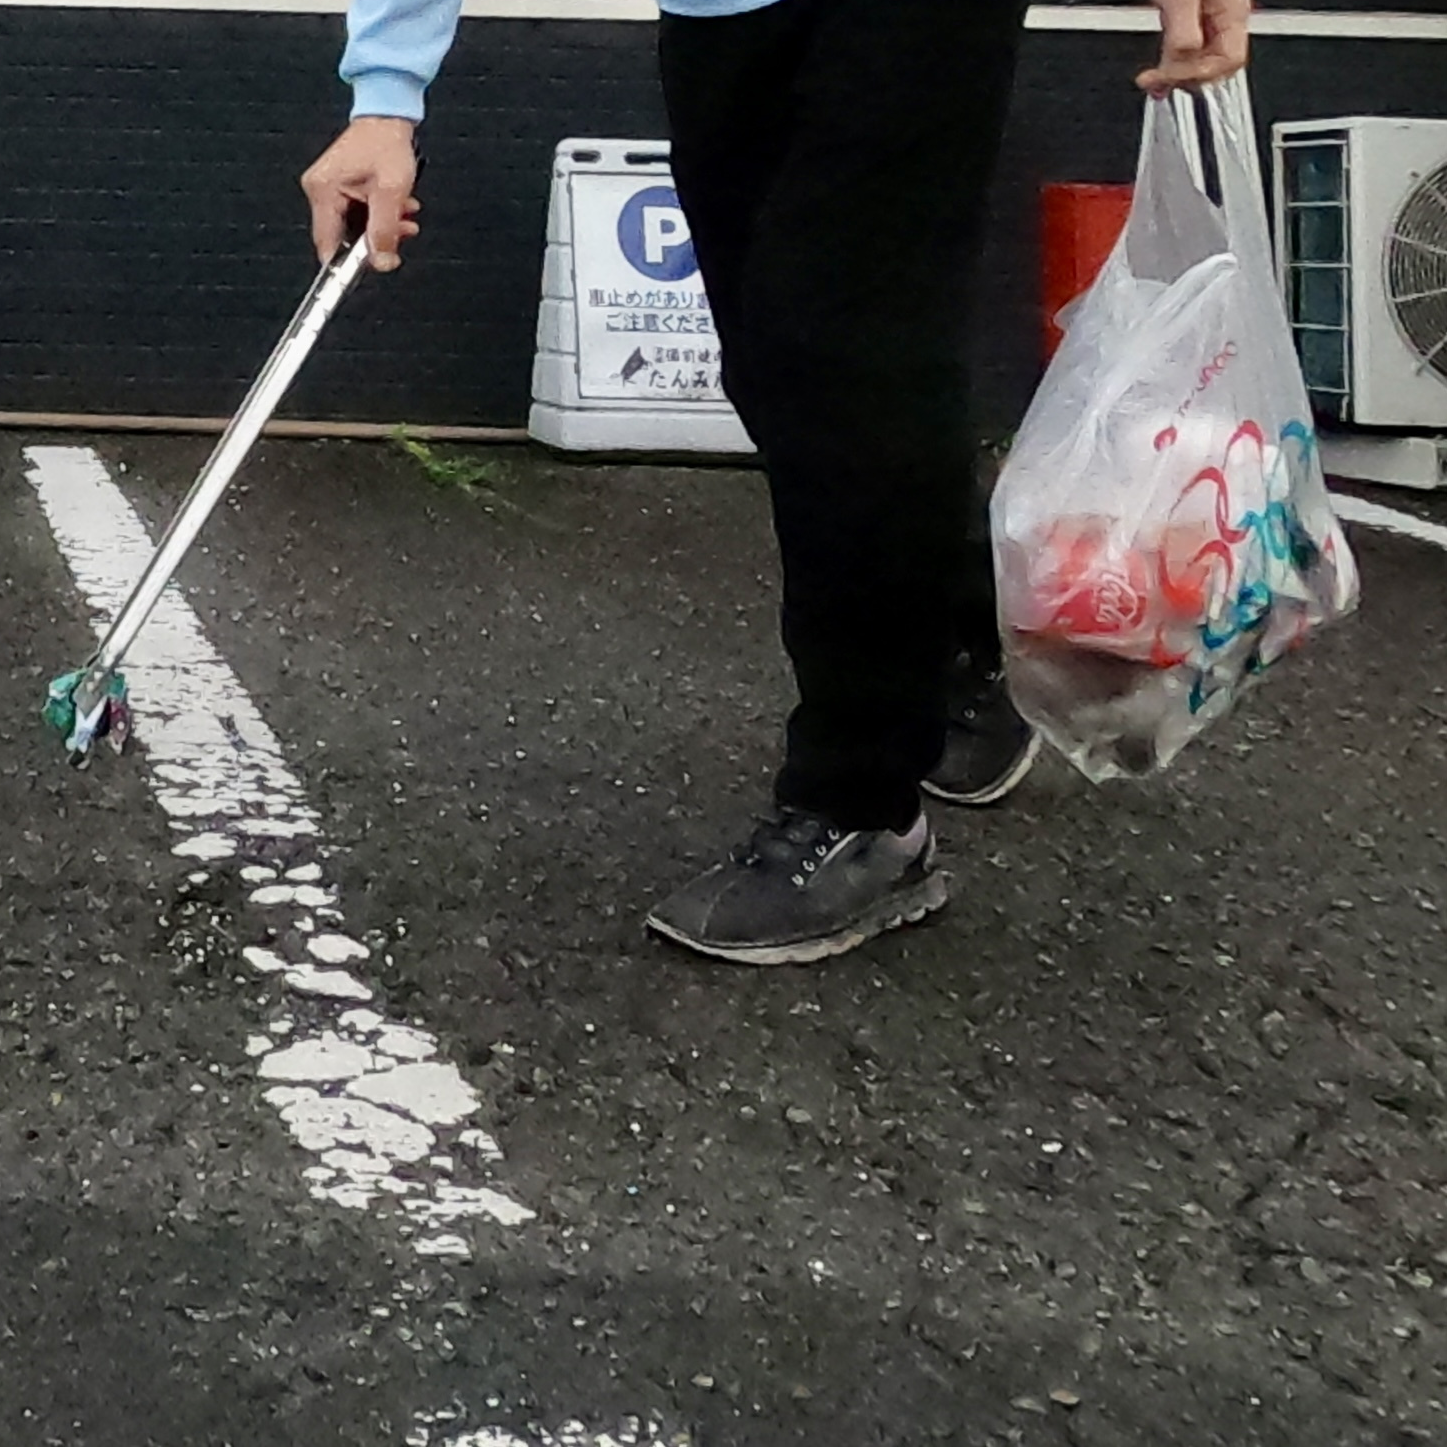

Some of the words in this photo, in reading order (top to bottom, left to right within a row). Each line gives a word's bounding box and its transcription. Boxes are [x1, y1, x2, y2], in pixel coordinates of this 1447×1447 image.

[642, 205, 691, 263] P
[649, 369, 721, 389] たんみ
